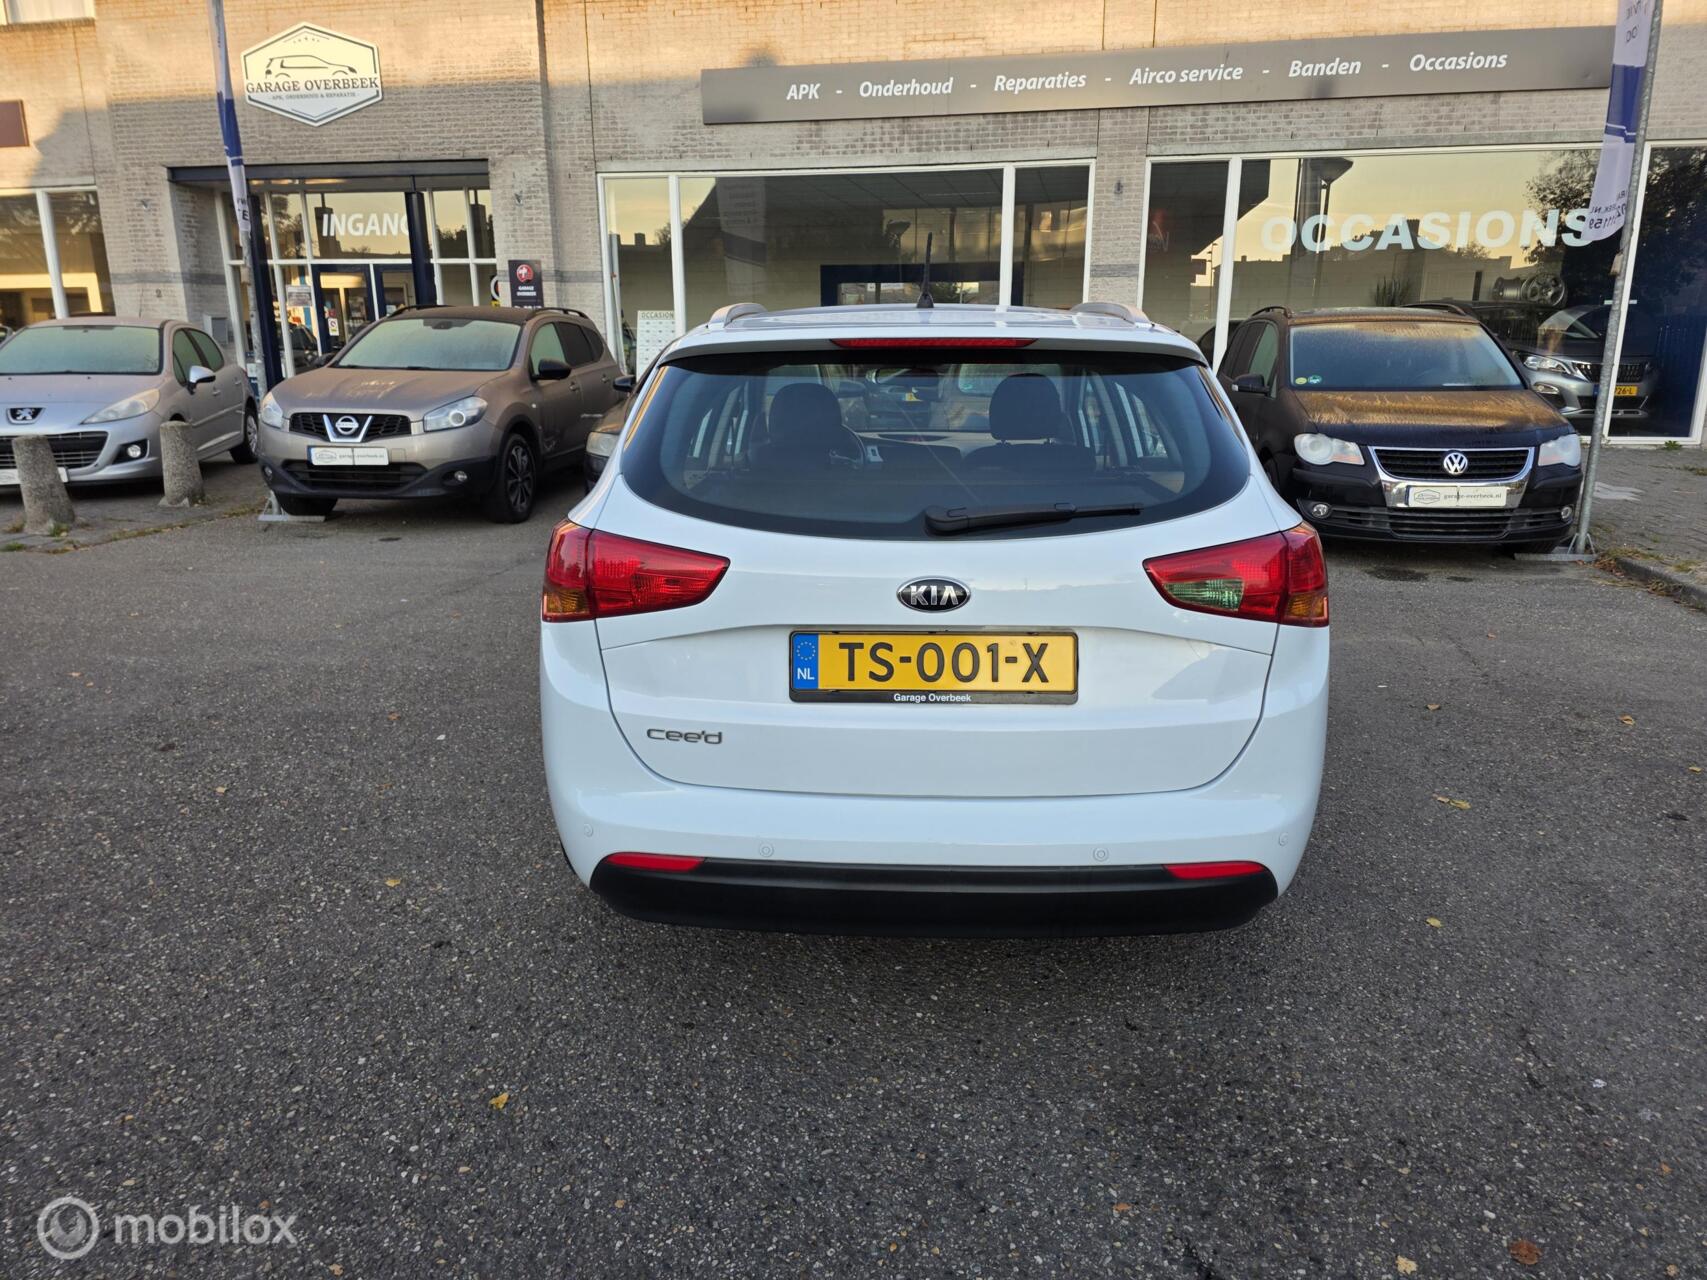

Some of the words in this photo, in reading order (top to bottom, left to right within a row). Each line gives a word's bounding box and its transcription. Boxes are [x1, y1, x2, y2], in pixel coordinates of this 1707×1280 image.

[246, 80, 300, 94] GARAGE
[304, 77, 379, 91] OVERBEEK
[786, 83, 820, 101] APK
[859, 77, 953, 97] Onderhoud
[994, 71, 1087, 94] Reparaties
[1129, 66, 1177, 85] Airco
[1179, 64, 1243, 83] service
[1288, 57, 1362, 77] Banden
[1409, 51, 1508, 72] Occasions
[1261, 208, 1592, 252] OCCASIONS
[909, 585, 960, 606] KIA
[838, 641, 1050, 683] TS-001-X
[797, 667, 815, 681] NL
[893, 692, 927, 704] Garage
[928, 692, 972, 702] Overbeek
